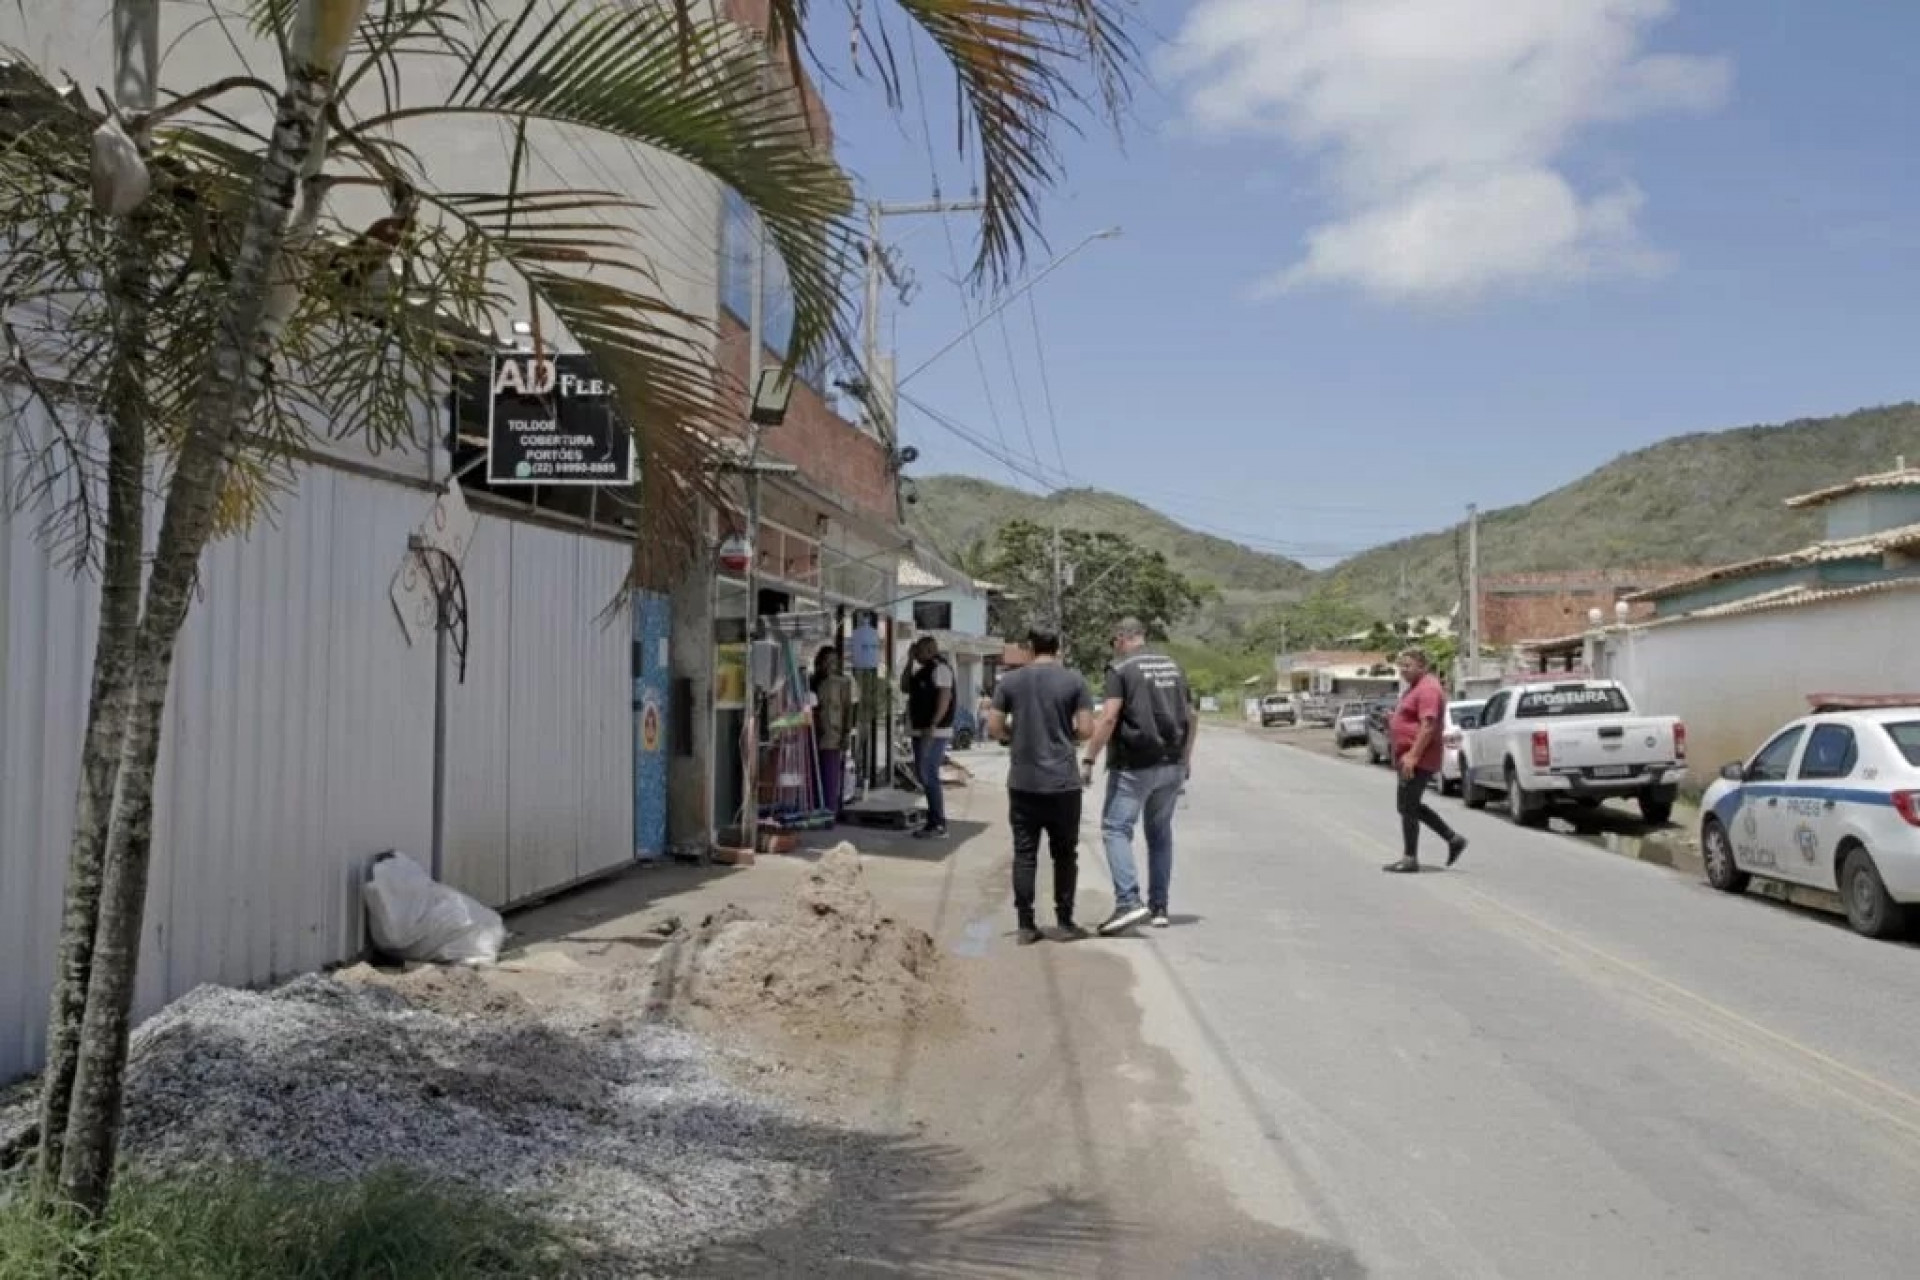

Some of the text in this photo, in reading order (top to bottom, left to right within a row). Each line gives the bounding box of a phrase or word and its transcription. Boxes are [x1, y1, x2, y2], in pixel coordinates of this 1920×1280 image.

[494, 359, 617, 398] AD FLE
[508, 419, 556, 432] TOLDOS
[520, 434, 595, 447] COBERTURA
[525, 448, 583, 461] PORTÕES
[1533, 689, 1608, 706] POSTURA
